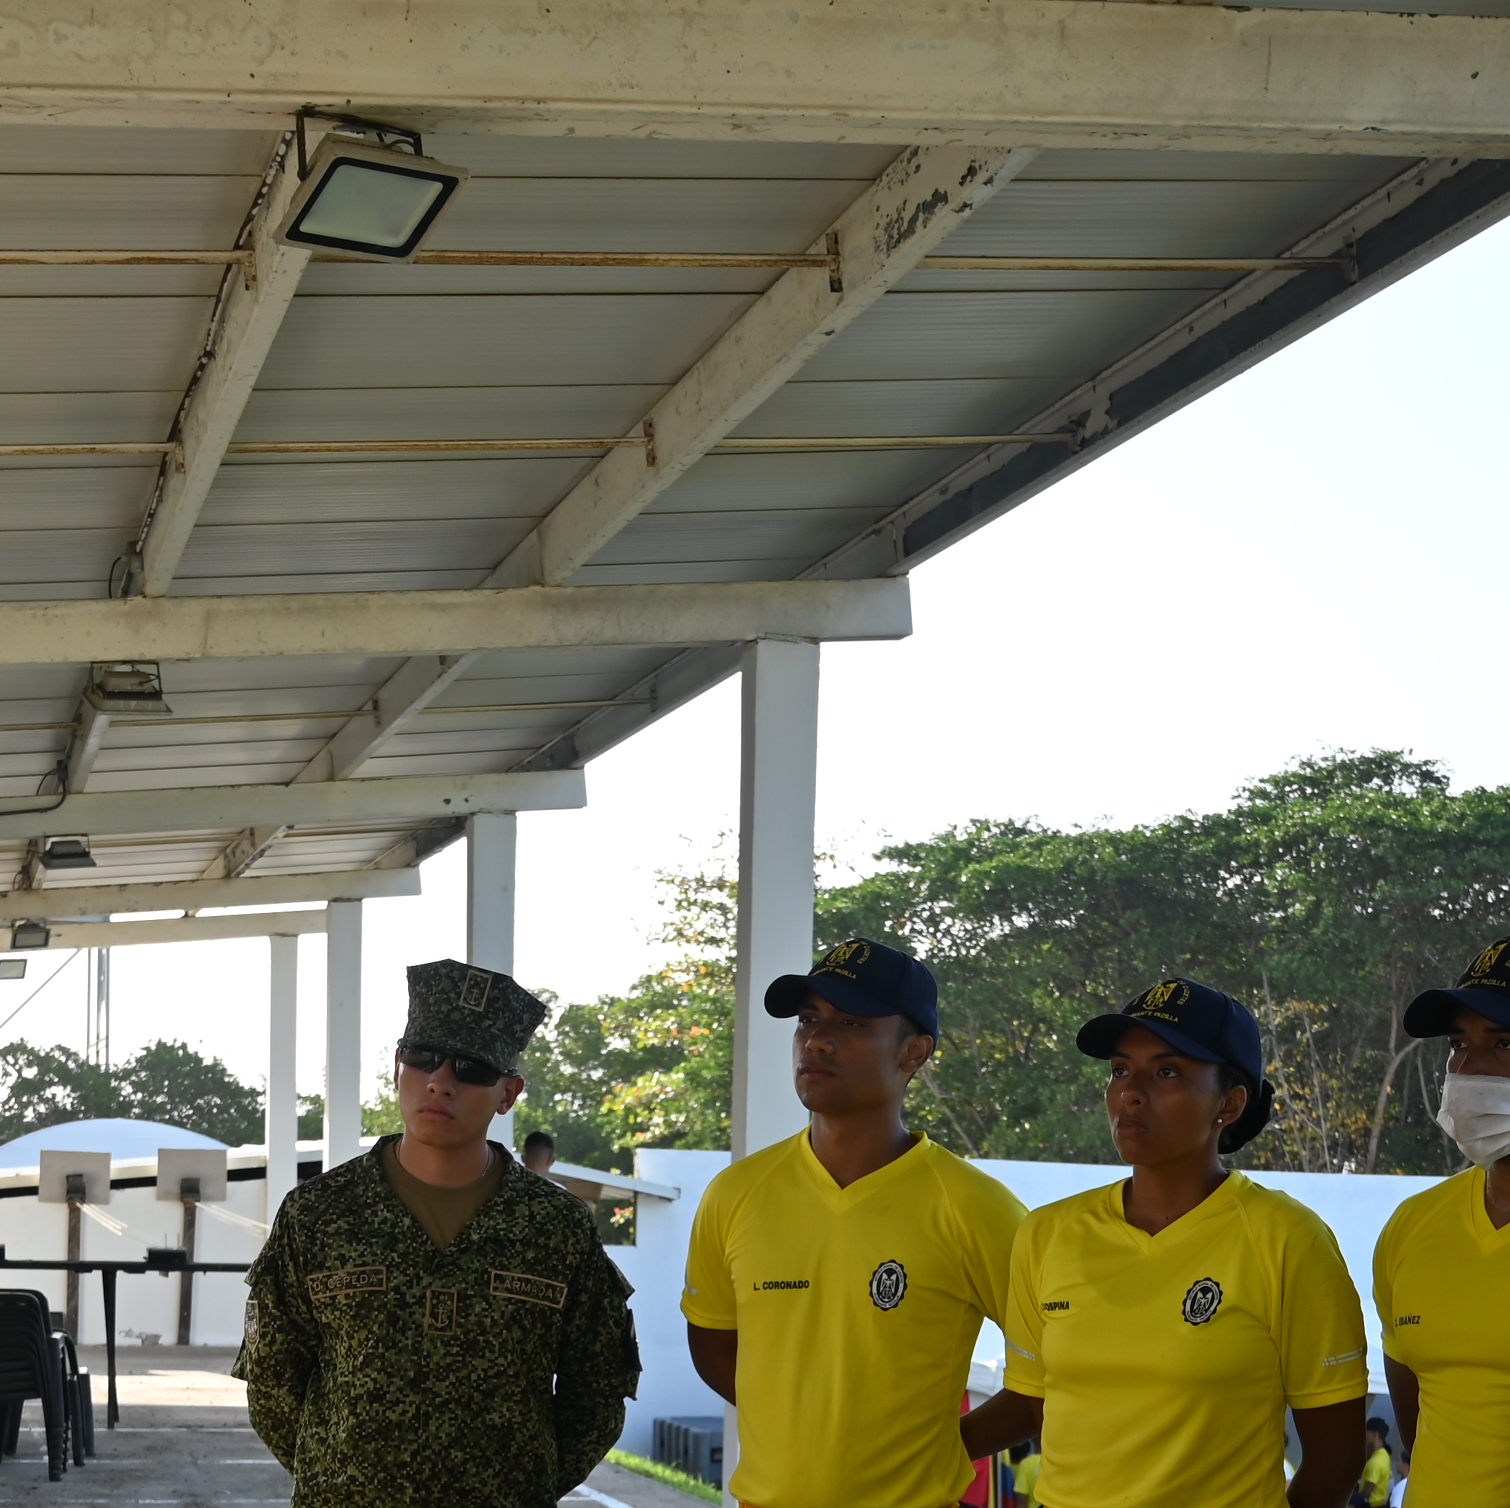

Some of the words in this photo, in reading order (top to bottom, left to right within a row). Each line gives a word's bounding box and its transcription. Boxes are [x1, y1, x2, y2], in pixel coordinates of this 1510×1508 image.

[327, 1273, 379, 1289] CEPEDA
[503, 1279, 553, 1298] ARMADA
[762, 1280, 810, 1290] CORONADO
